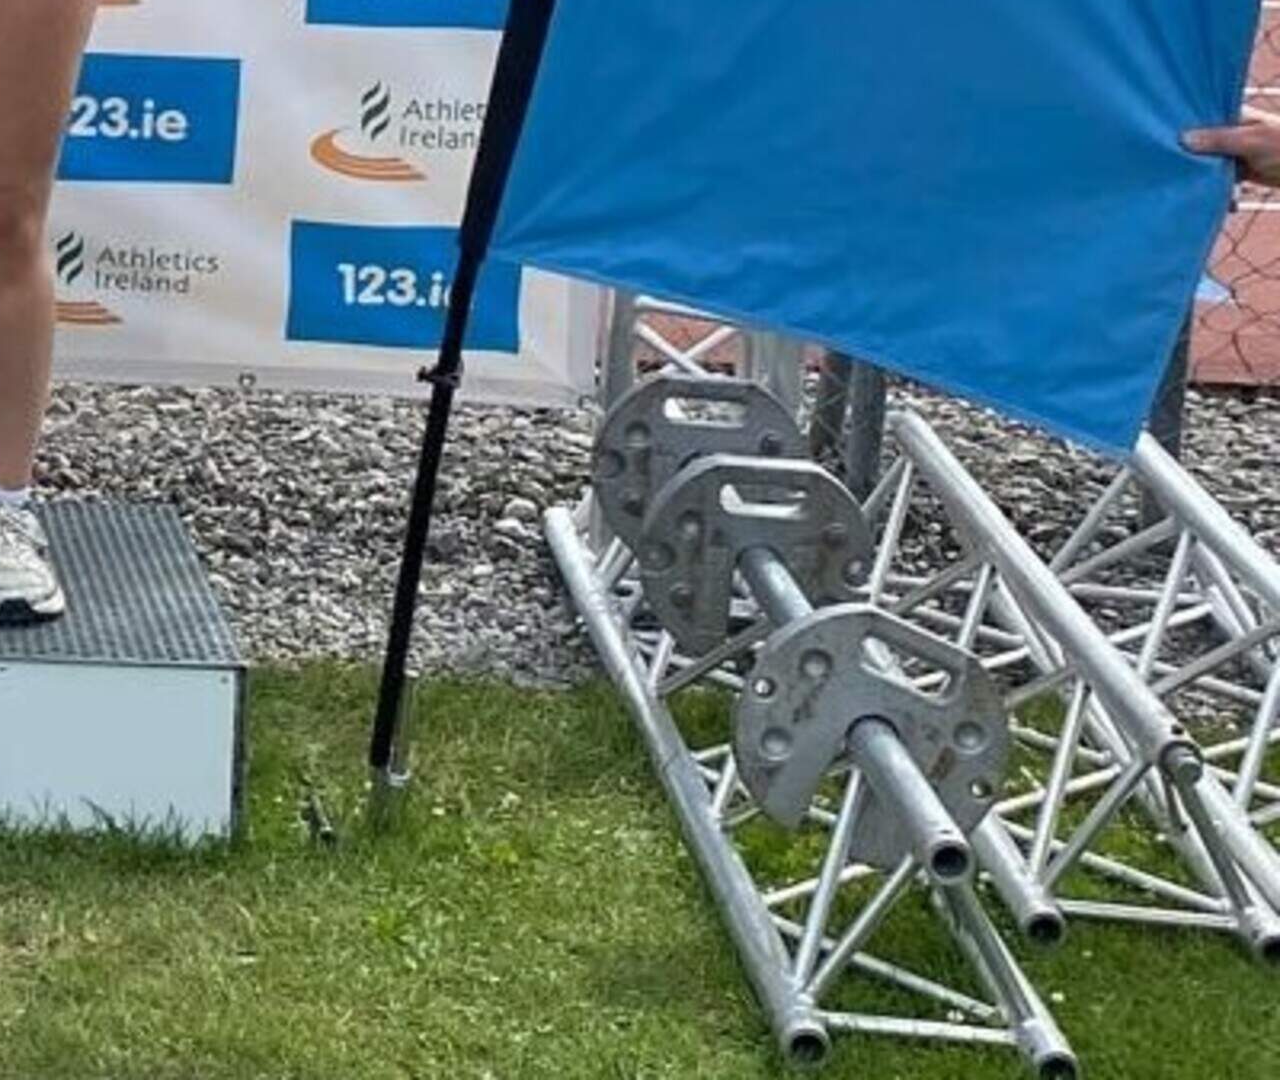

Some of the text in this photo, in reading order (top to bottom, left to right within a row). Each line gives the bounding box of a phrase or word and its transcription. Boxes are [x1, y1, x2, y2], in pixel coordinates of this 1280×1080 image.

[69, 96, 187, 140] 23.ie
[399, 126, 481, 151] Irelan
[96, 245, 220, 272] Athletics
[93, 270, 190, 294] Ireland
[339, 264, 450, 307] 123.i
